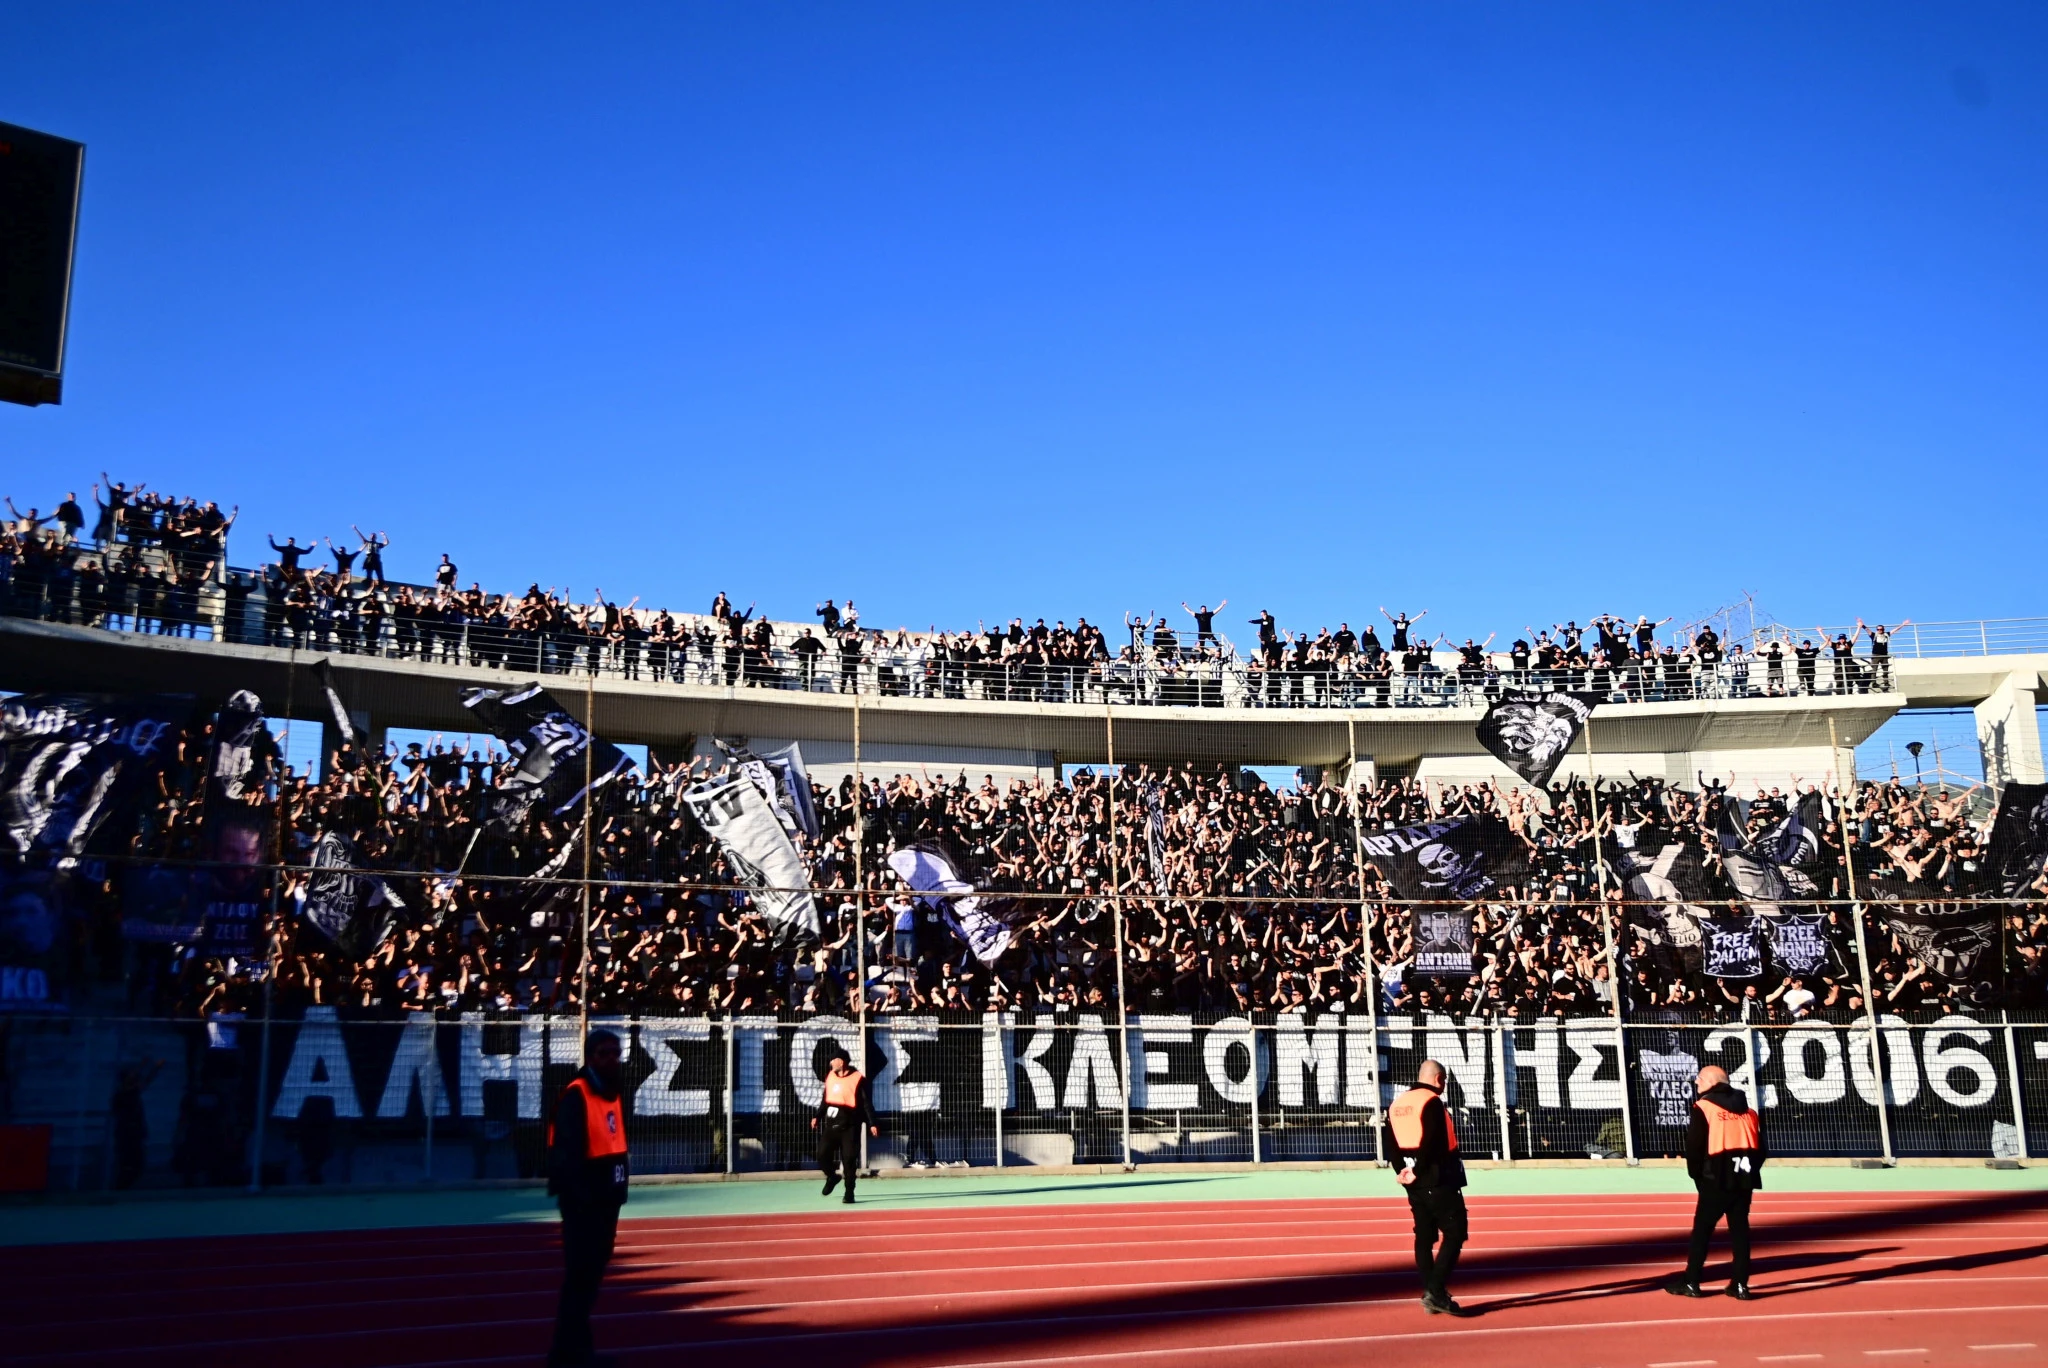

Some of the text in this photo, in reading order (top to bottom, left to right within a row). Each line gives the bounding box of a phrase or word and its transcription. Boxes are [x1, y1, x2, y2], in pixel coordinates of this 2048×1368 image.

[1710, 931, 1753, 950] FREE
[1779, 924, 1816, 941] FREE
[1709, 946, 1759, 966] DALTON
[1770, 940, 1826, 958] MANOS
[982, 1011, 1625, 1111] ΚΛΕΟΜΕΝΗΣ
[1703, 1014, 1998, 1111] 2006
[1732, 1156, 1751, 1173] 74
